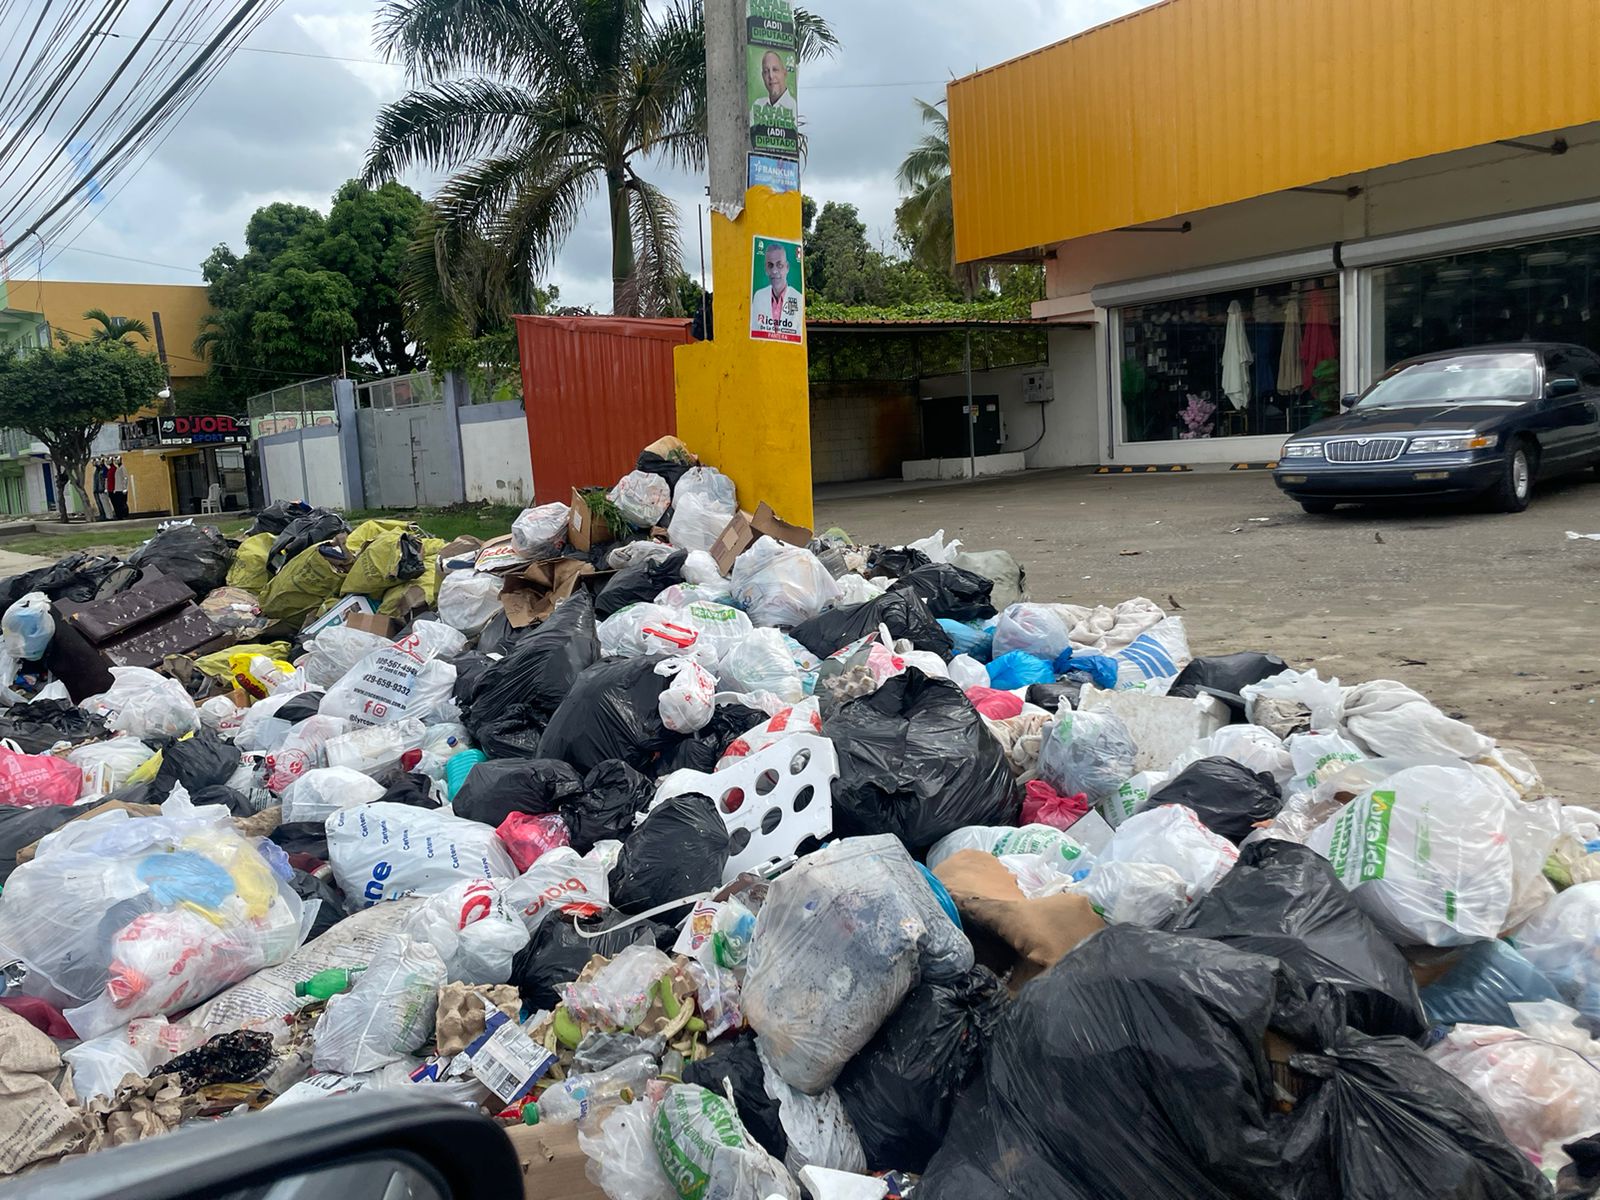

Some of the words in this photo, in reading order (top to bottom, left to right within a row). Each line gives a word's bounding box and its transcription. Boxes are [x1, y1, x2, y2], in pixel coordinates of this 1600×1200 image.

[763, 19, 782, 31] (ADI)
[753, 28, 793, 42] DIPUTADO
[767, 127, 785, 139] (ADI)
[756, 137, 796, 149] DIPUTADO
[758, 164, 795, 177] FRANKLIN
[757, 314, 793, 327] Ricardo
[175, 416, 239, 433] D'JOEL
[191, 433, 224, 443] SPORT
[1363, 802, 1386, 877] aprezio
